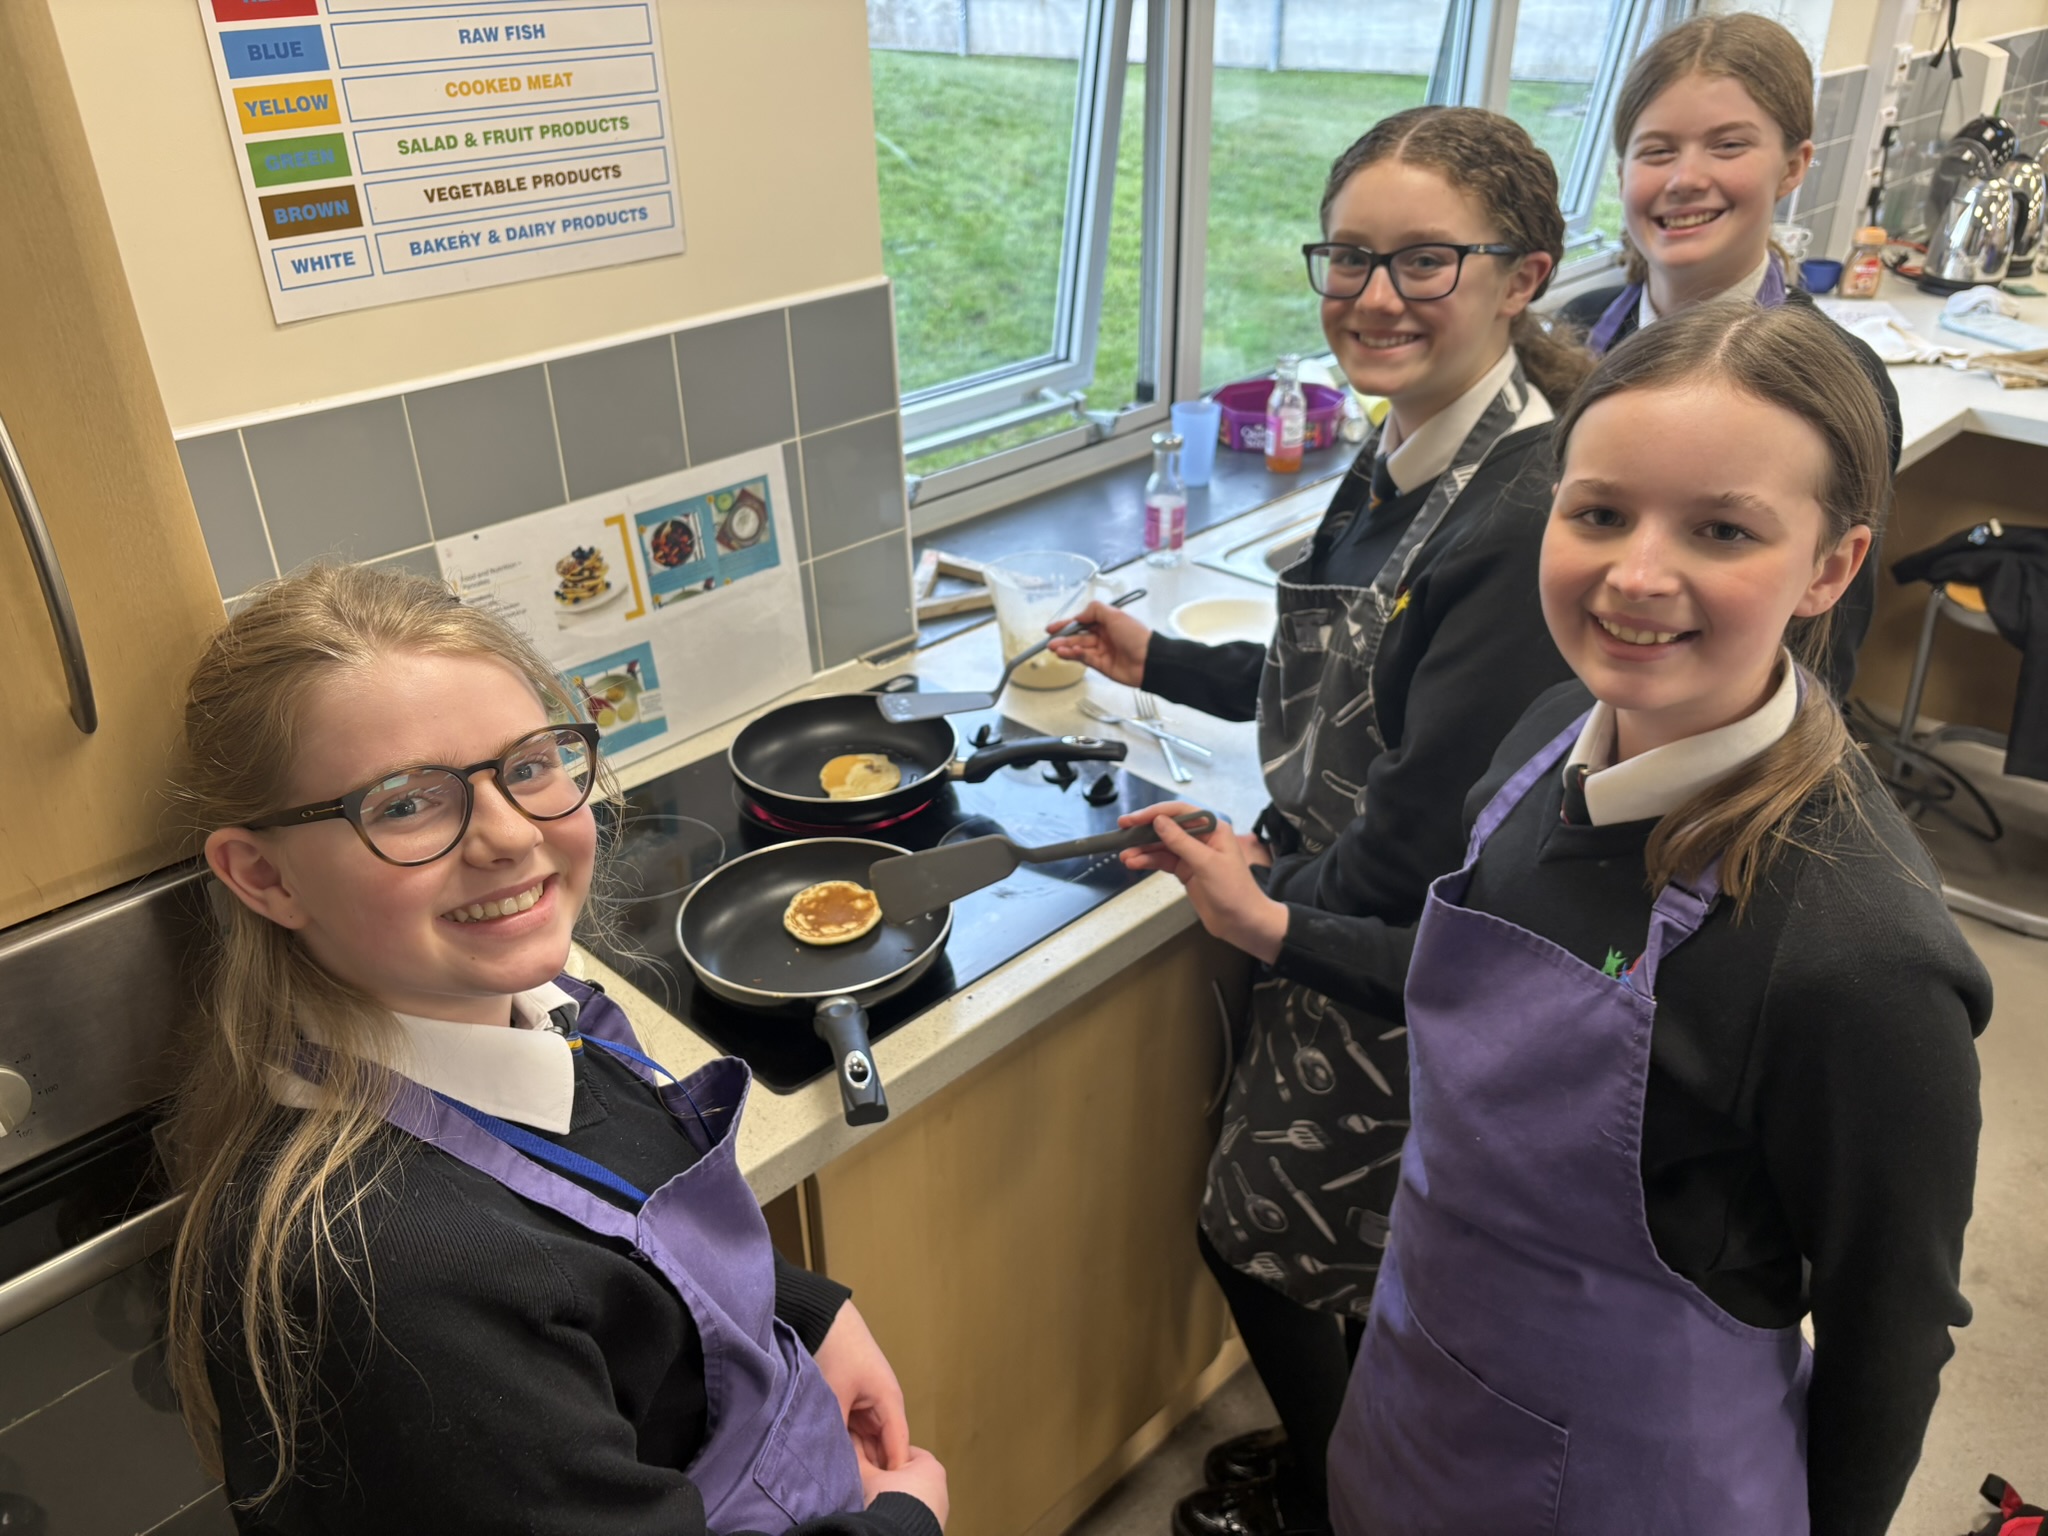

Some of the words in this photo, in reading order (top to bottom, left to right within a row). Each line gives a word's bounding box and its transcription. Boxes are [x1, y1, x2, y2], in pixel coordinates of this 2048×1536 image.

[458, 26, 499, 44] RAW
[504, 23, 546, 41] FISH
[247, 41, 304, 61] BLUE
[445, 77, 522, 98] COOKED
[526, 72, 573, 91] MEAT
[244, 94, 329, 117] YELLOW
[397, 134, 459, 156] SALAD
[464, 132, 478, 148] &
[482, 126, 534, 146] FRUIT
[539, 116, 630, 140] PRODUCTS
[264, 148, 336, 172] GREEN
[424, 176, 528, 203] VEGETABLE
[532, 164, 622, 189] PRODUCTS
[273, 199, 349, 225] BROWN
[409, 231, 482, 256] BAKERY
[488, 229, 501, 245] &
[505, 221, 556, 242] DAIRY
[562, 207, 648, 233] PRODUCTS
[290, 251, 356, 275] WHITE
